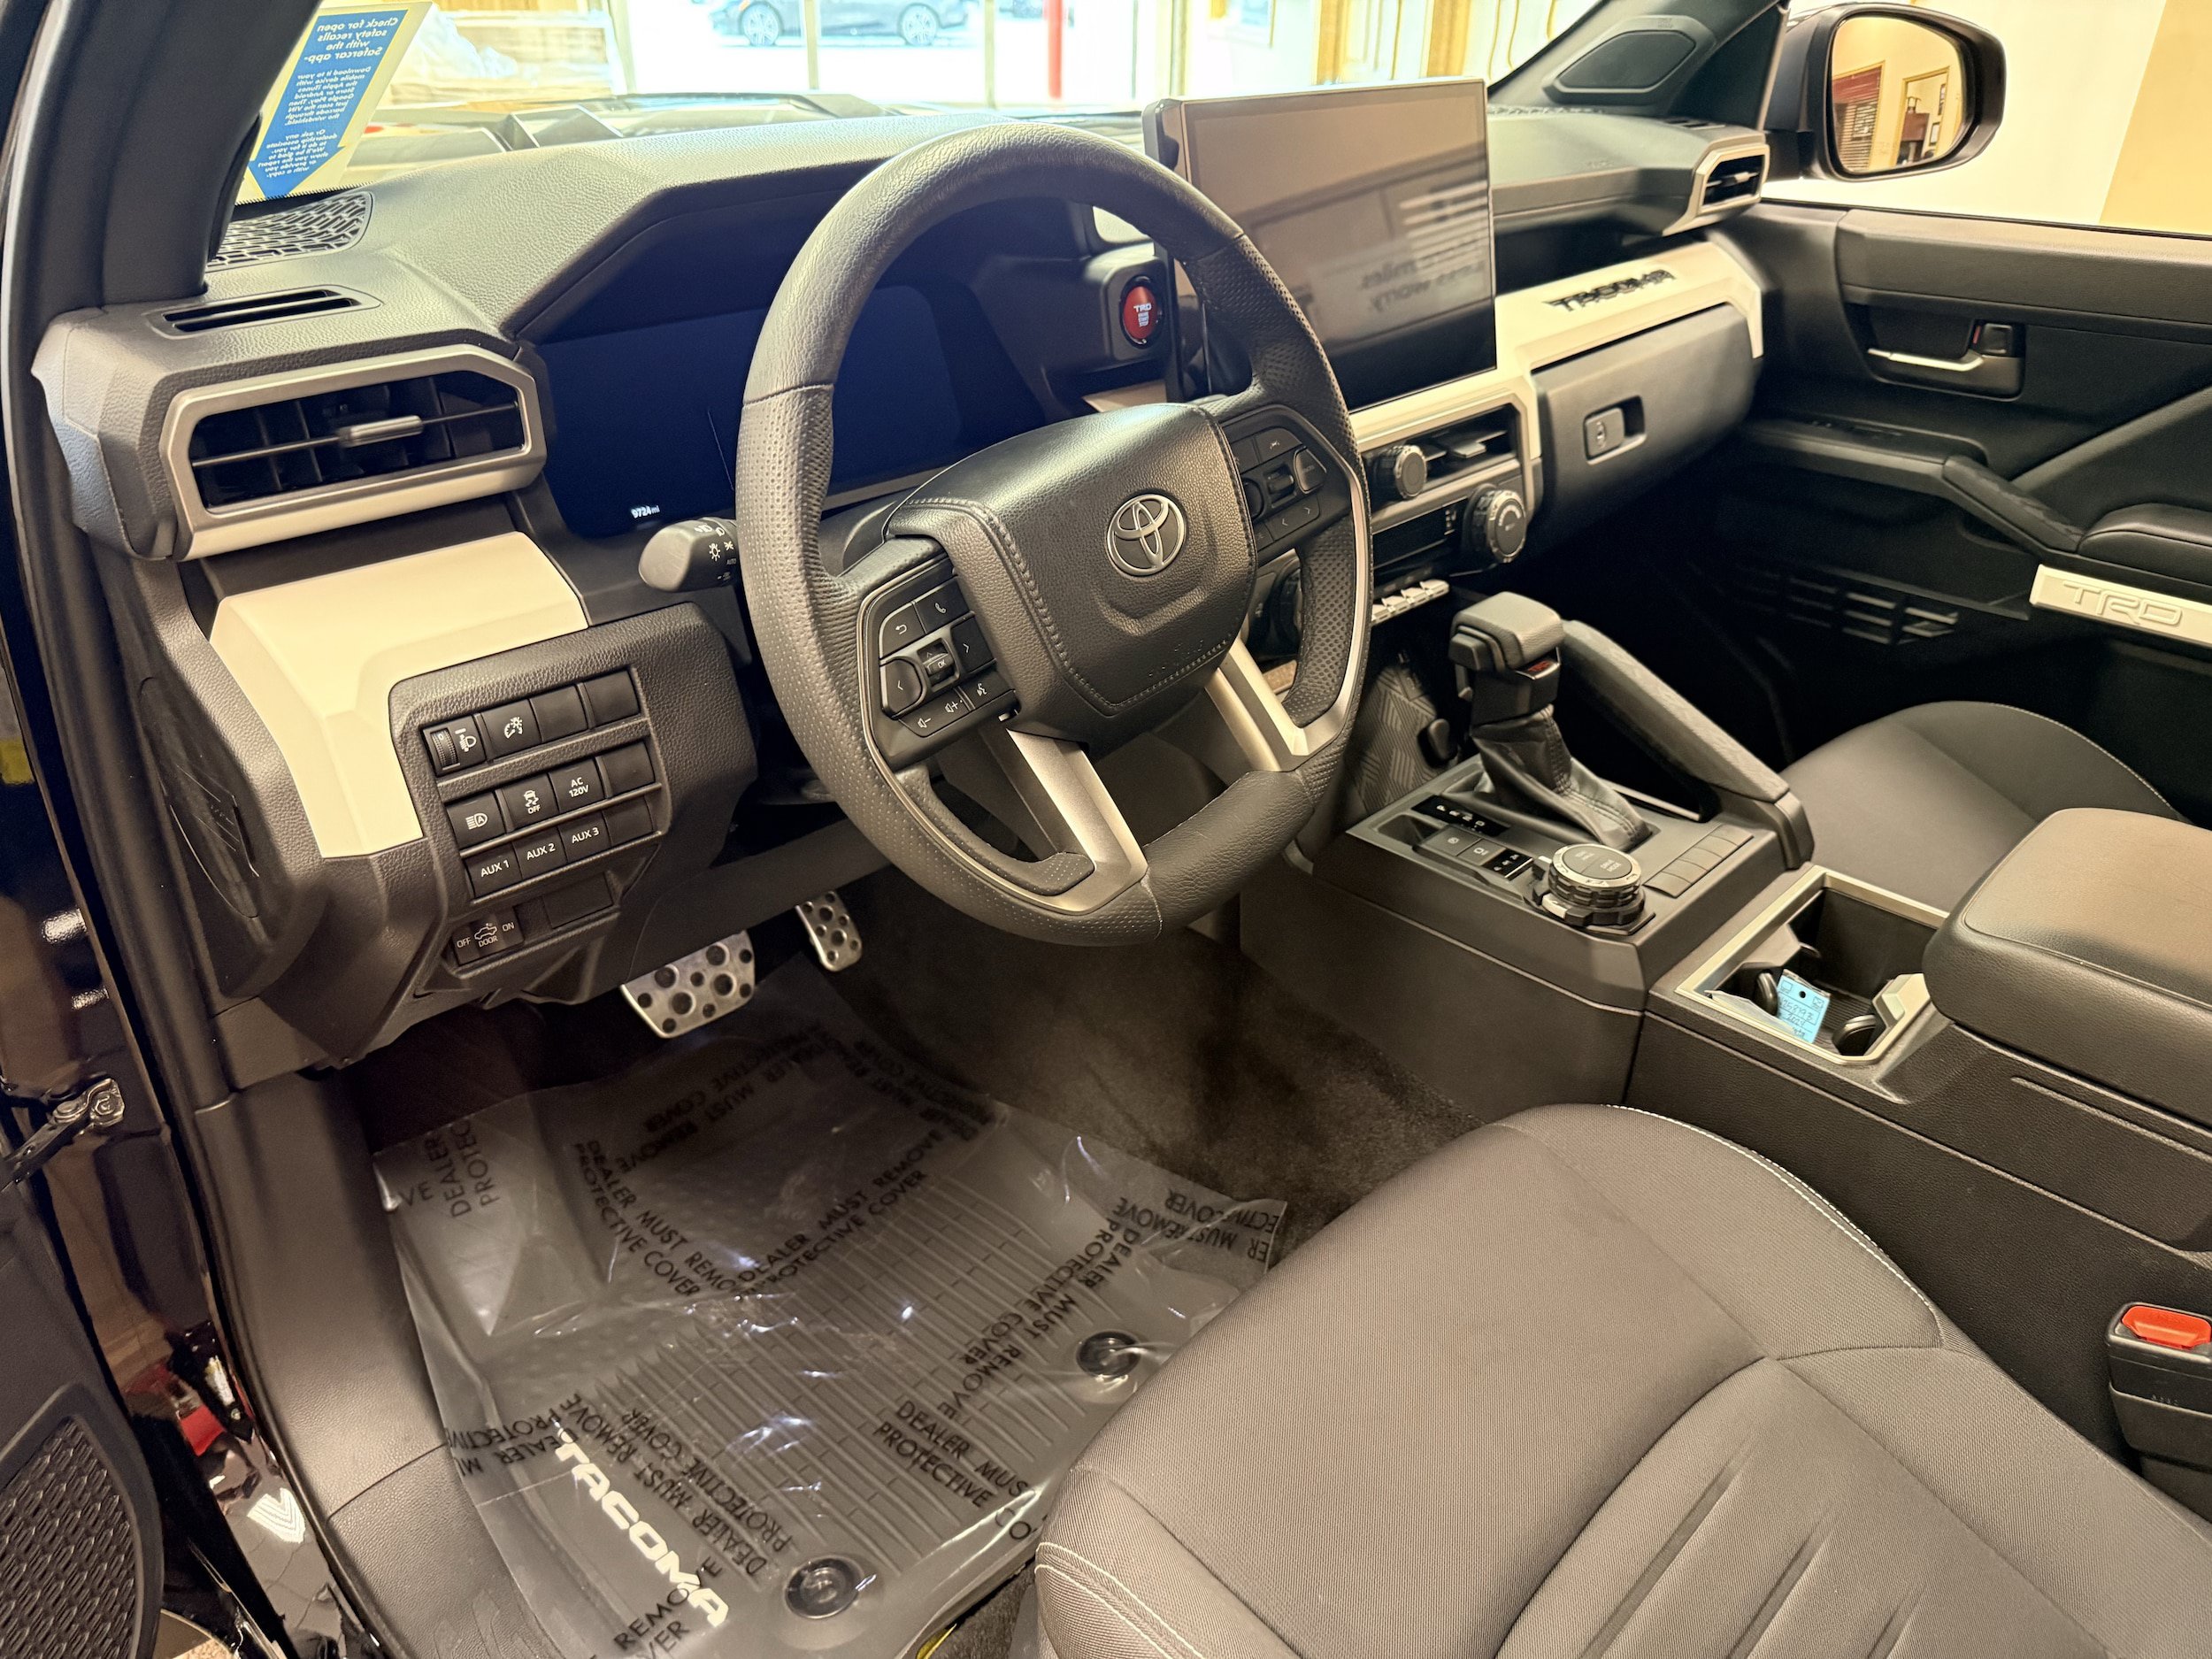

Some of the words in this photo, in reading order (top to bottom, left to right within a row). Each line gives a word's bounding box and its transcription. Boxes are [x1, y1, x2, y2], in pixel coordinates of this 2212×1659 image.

[2062, 580, 2184, 627] TRD
[938, 659, 947, 669] OK
[569, 784, 589, 798] 120V
[571, 777, 584, 787] AC
[527, 804, 541, 815] OFF
[526, 846, 548, 861] AUX
[548, 842, 557, 852] 2
[571, 830, 592, 844] AUX
[592, 826, 601, 837] 3
[480, 863, 503, 878] AUX
[503, 859, 511, 869] 1
[457, 937, 472, 949] OFF
[479, 935, 498, 948] DOOR
[502, 922, 515, 932] ON
[425, 1139, 472, 1218] DEALER
[818, 1189, 869, 1231] MUST
[872, 1129, 944, 1188] REMOVE
[868, 1169, 928, 1216] COVER
[574, 1142, 648, 1254] PROTECTIVE
[643, 1250, 702, 1297] COVER
[587, 1140, 638, 1209] DEALER
[635, 1209, 689, 1251] MUST
[684, 1250, 747, 1294] REMO
[1111, 1196, 1189, 1240] REMOVE
[1188, 1225, 1238, 1250] MUST
[1024, 1217, 1121, 1312] PROTECTIVE
[1078, 1227, 1141, 1288] DEALER
[961, 1312, 1024, 1365] COVER
[1025, 1294, 1078, 1340] MUST
[937, 1344, 1022, 1420] REMOVE
[493, 1427, 580, 1467] DEALER
[559, 1393, 639, 1464] REMOVE
[620, 1408, 684, 1461] COVER
[896, 1399, 972, 1460] DEALER
[634, 1461, 694, 1510] MUST
[872, 1420, 995, 1508] PROTECTIVE
[554, 1427, 730, 1629] TACOMA
[681, 1456, 794, 1554] PROTECTIVE
[691, 1508, 768, 1577] DEALER
[613, 1555, 724, 1652] REMOVE
